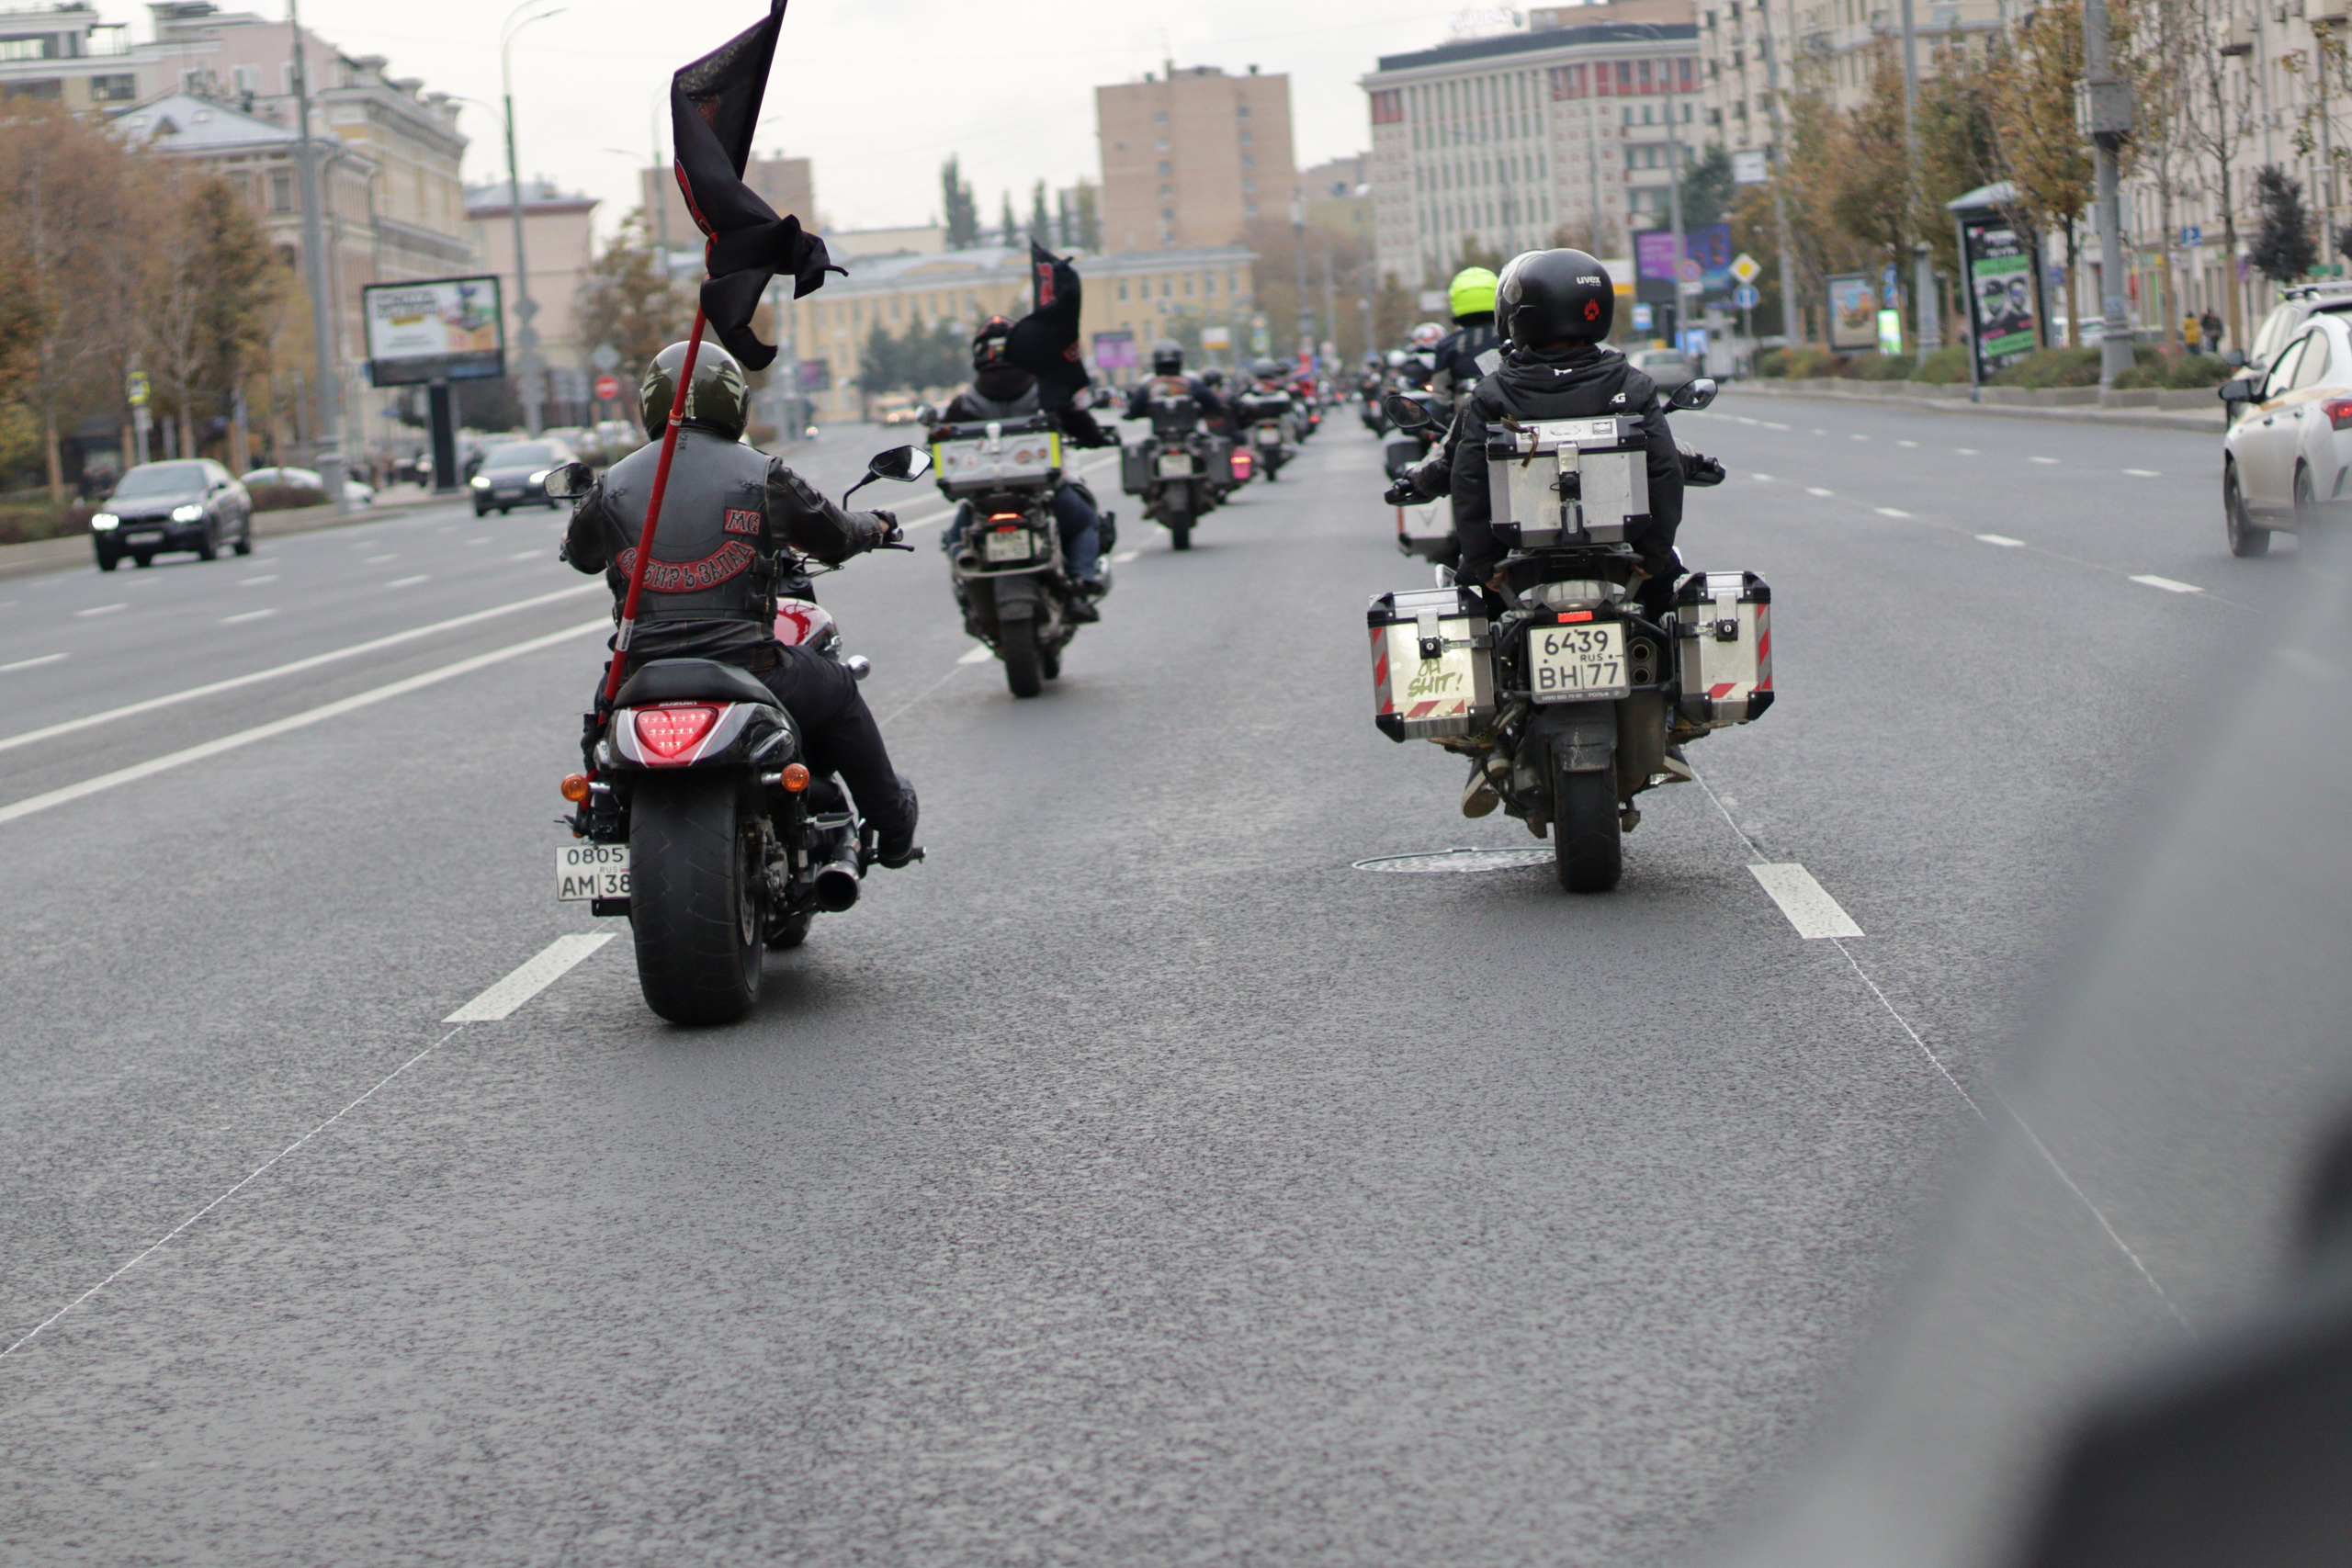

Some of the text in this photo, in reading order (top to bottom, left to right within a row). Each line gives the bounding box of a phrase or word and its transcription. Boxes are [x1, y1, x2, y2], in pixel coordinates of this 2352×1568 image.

[1577, 276, 1601, 284] uvex
[1544, 630, 1609, 655] 6439
[1580, 653, 1603, 661] RUS
[1539, 662, 1618, 689] BH 77
[567, 848, 624, 864] 0805
[561, 874, 631, 897] AM 38
